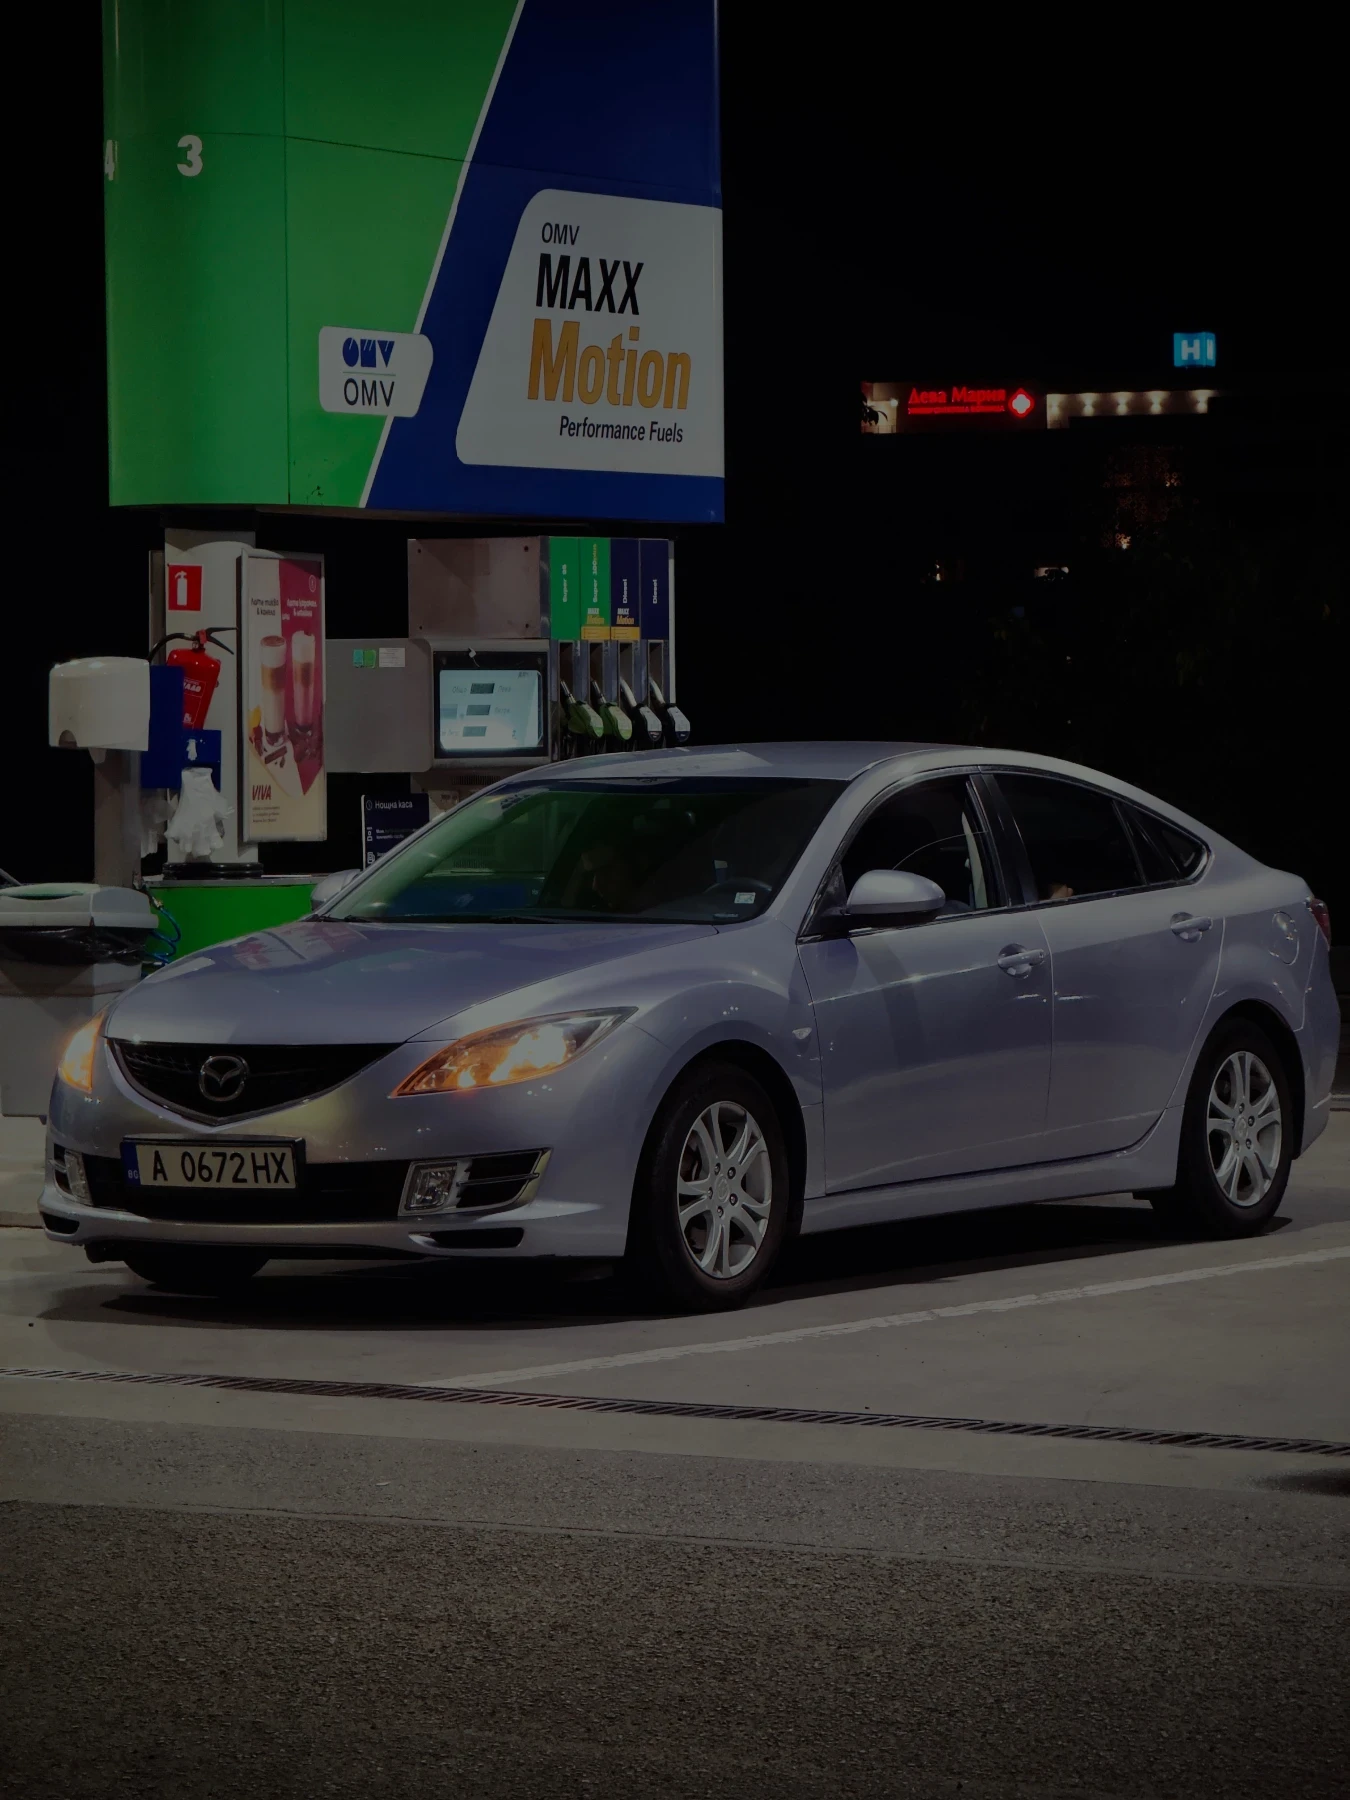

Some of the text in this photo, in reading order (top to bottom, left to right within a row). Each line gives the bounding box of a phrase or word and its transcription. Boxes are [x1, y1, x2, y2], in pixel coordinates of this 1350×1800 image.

[177, 134, 204, 177] 3
[541, 222, 580, 246] OMV
[536, 253, 644, 315] MAXX
[342, 337, 395, 368] OMV
[527, 318, 691, 410] Motion
[343, 378, 395, 407] OMV
[559, 415, 684, 443] Performance Fuels
[252, 784, 271, 801] VIVA
[153, 1150, 168, 1181] A
